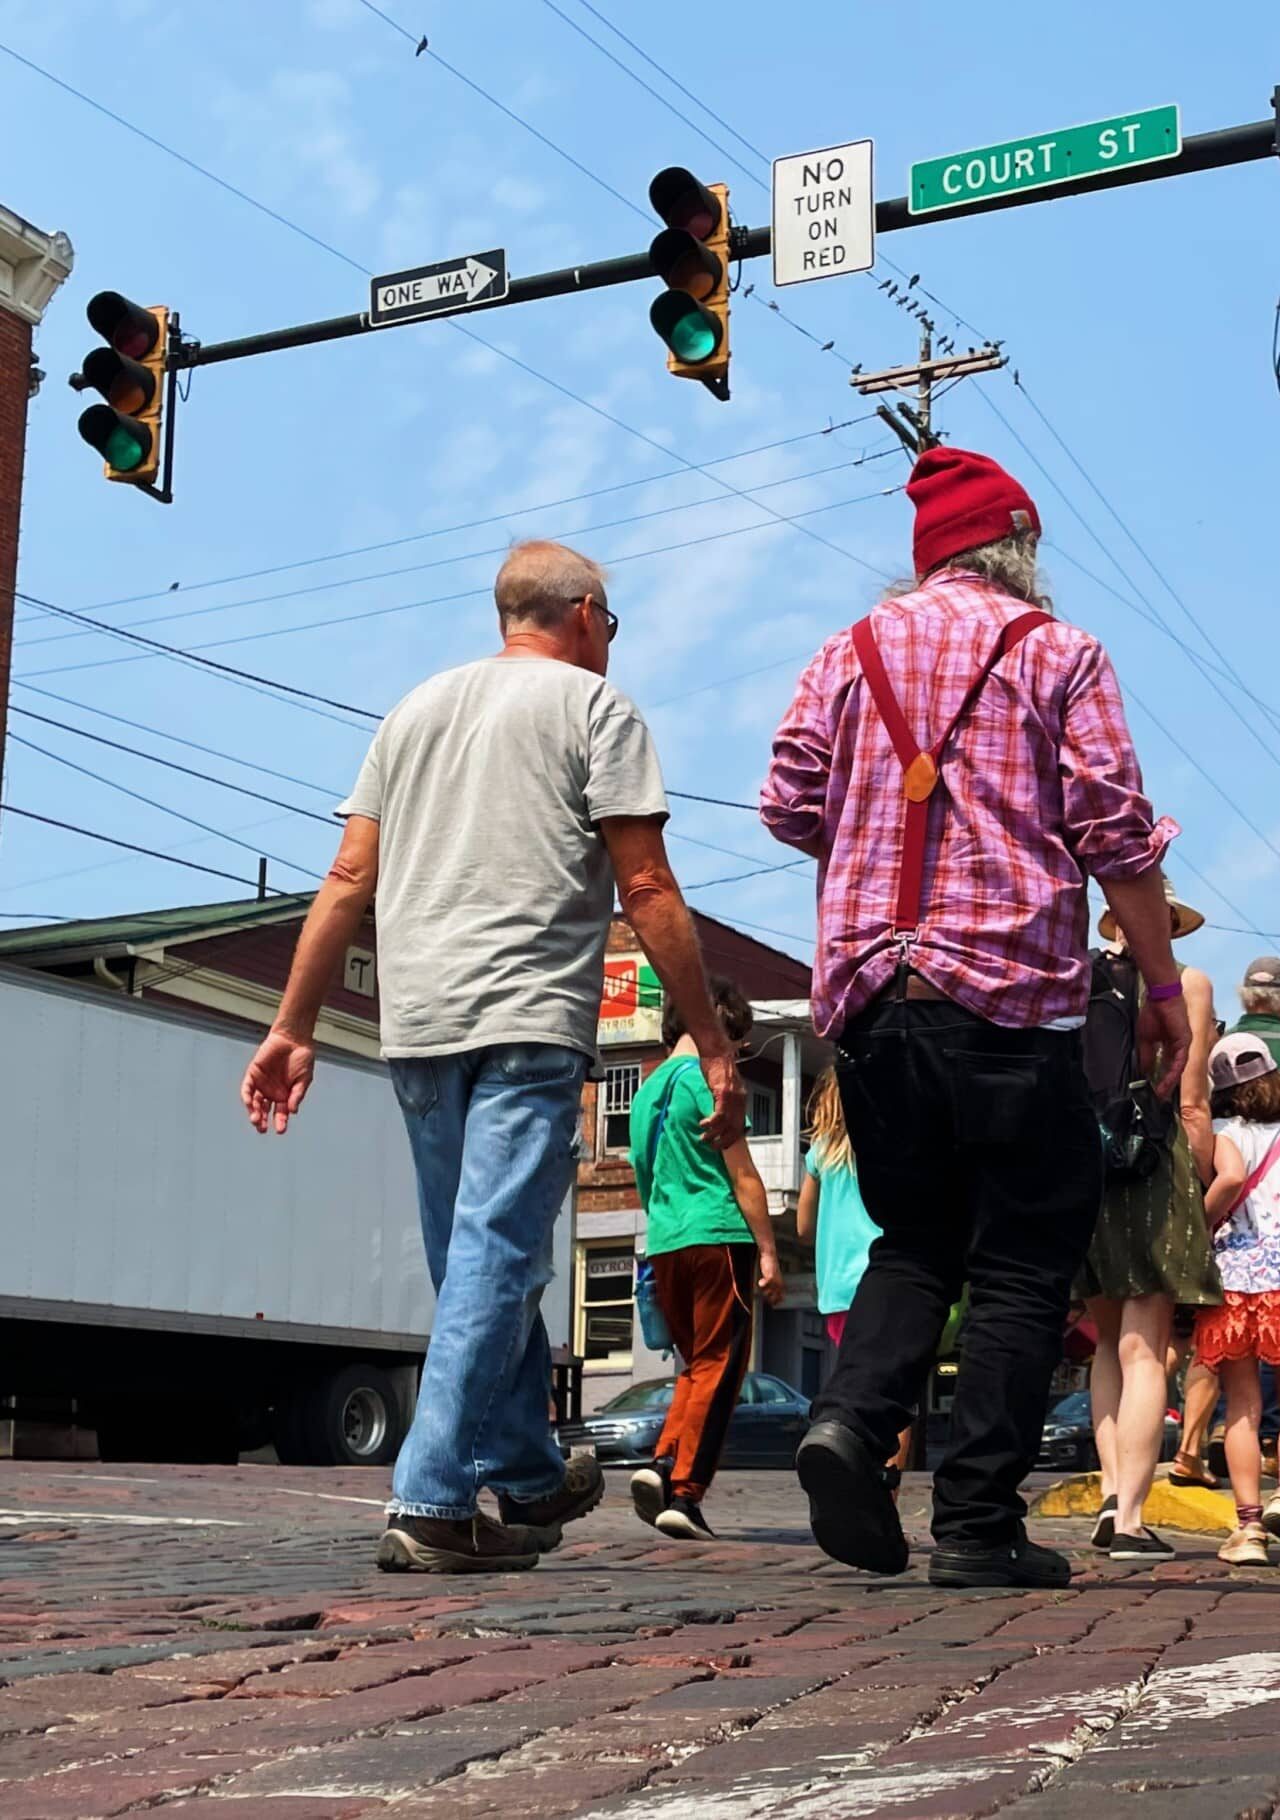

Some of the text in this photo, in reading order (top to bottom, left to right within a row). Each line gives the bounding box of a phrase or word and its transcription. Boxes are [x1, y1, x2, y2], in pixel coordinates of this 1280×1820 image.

[802, 158, 844, 187] NO
[942, 123, 1141, 194] COURT ST
[794, 187, 851, 216] TURN
[809, 217, 837, 241] ON
[803, 245, 846, 271] RED
[383, 269, 478, 306] ONE WAY
[590, 1259, 633, 1274] GYROS
